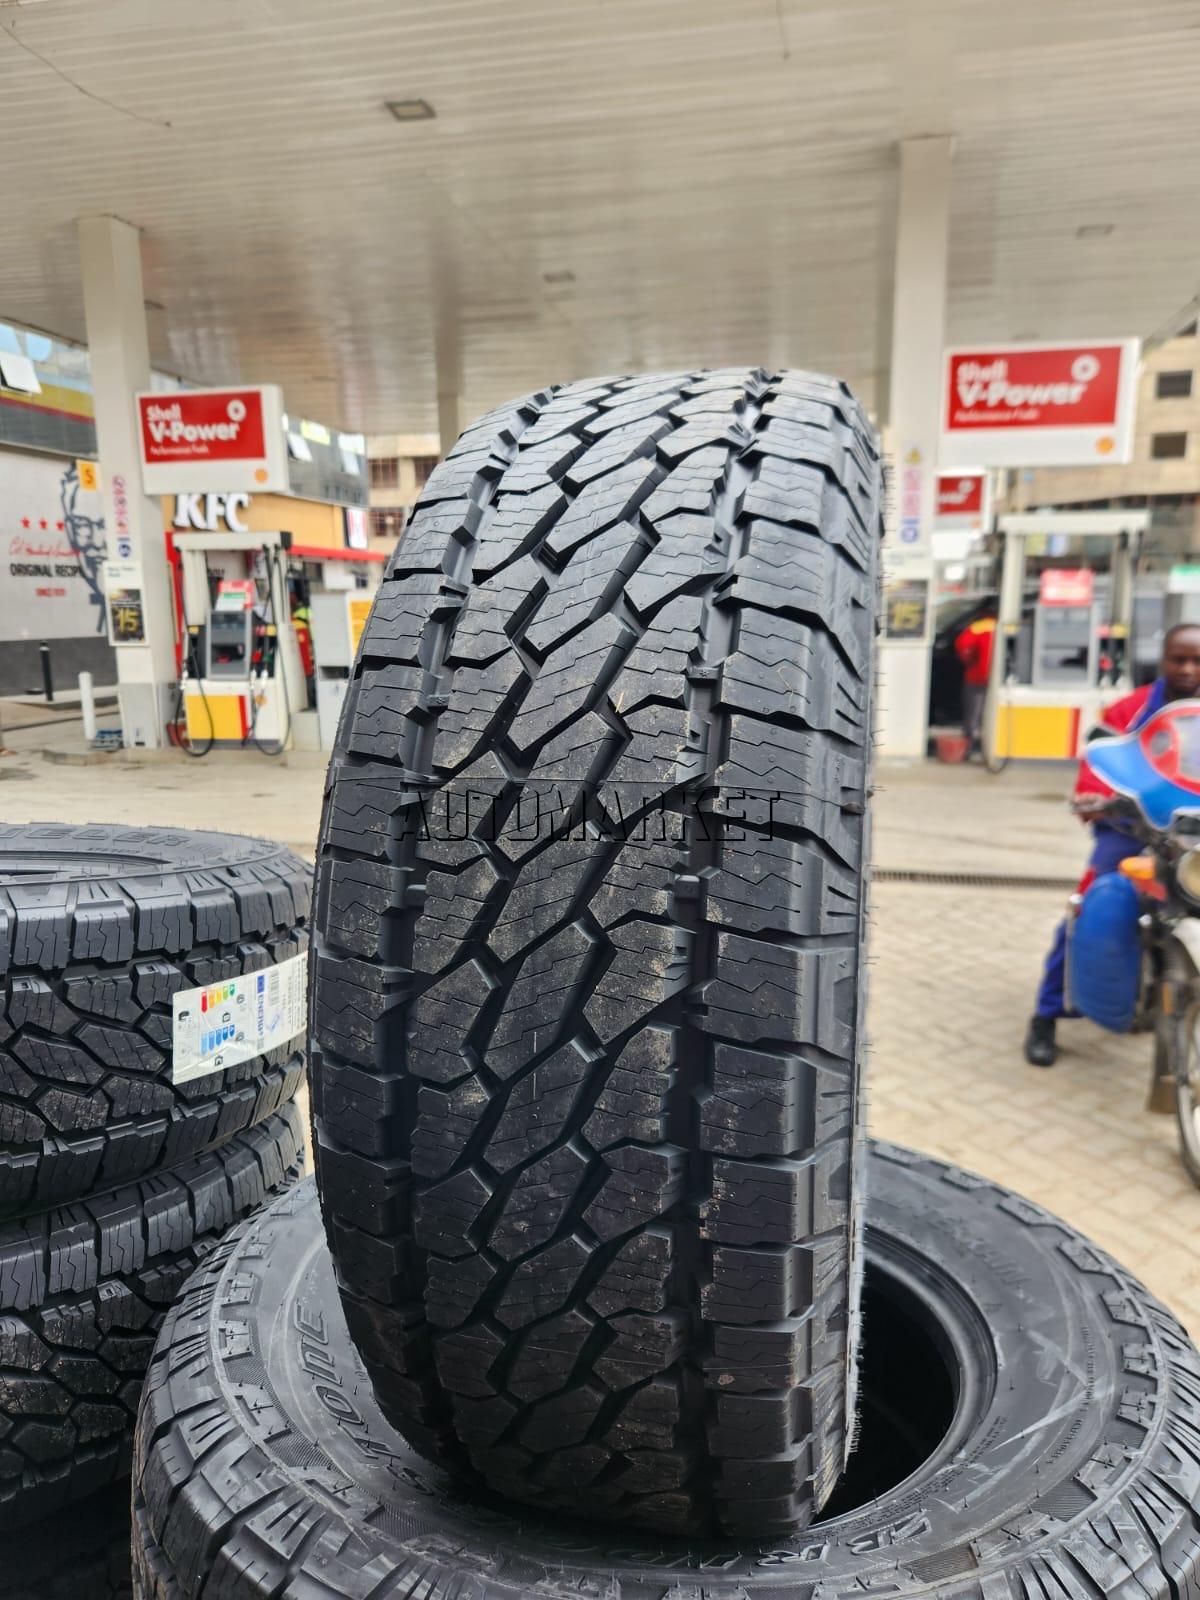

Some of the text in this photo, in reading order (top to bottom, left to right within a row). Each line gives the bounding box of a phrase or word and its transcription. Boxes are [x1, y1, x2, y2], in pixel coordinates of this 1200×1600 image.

[957, 360, 1007, 381] Shell
[957, 381, 1087, 407] V-Power
[147, 403, 181, 421] Shell
[149, 420, 240, 443] V-Power
[174, 493, 249, 532] KFC
